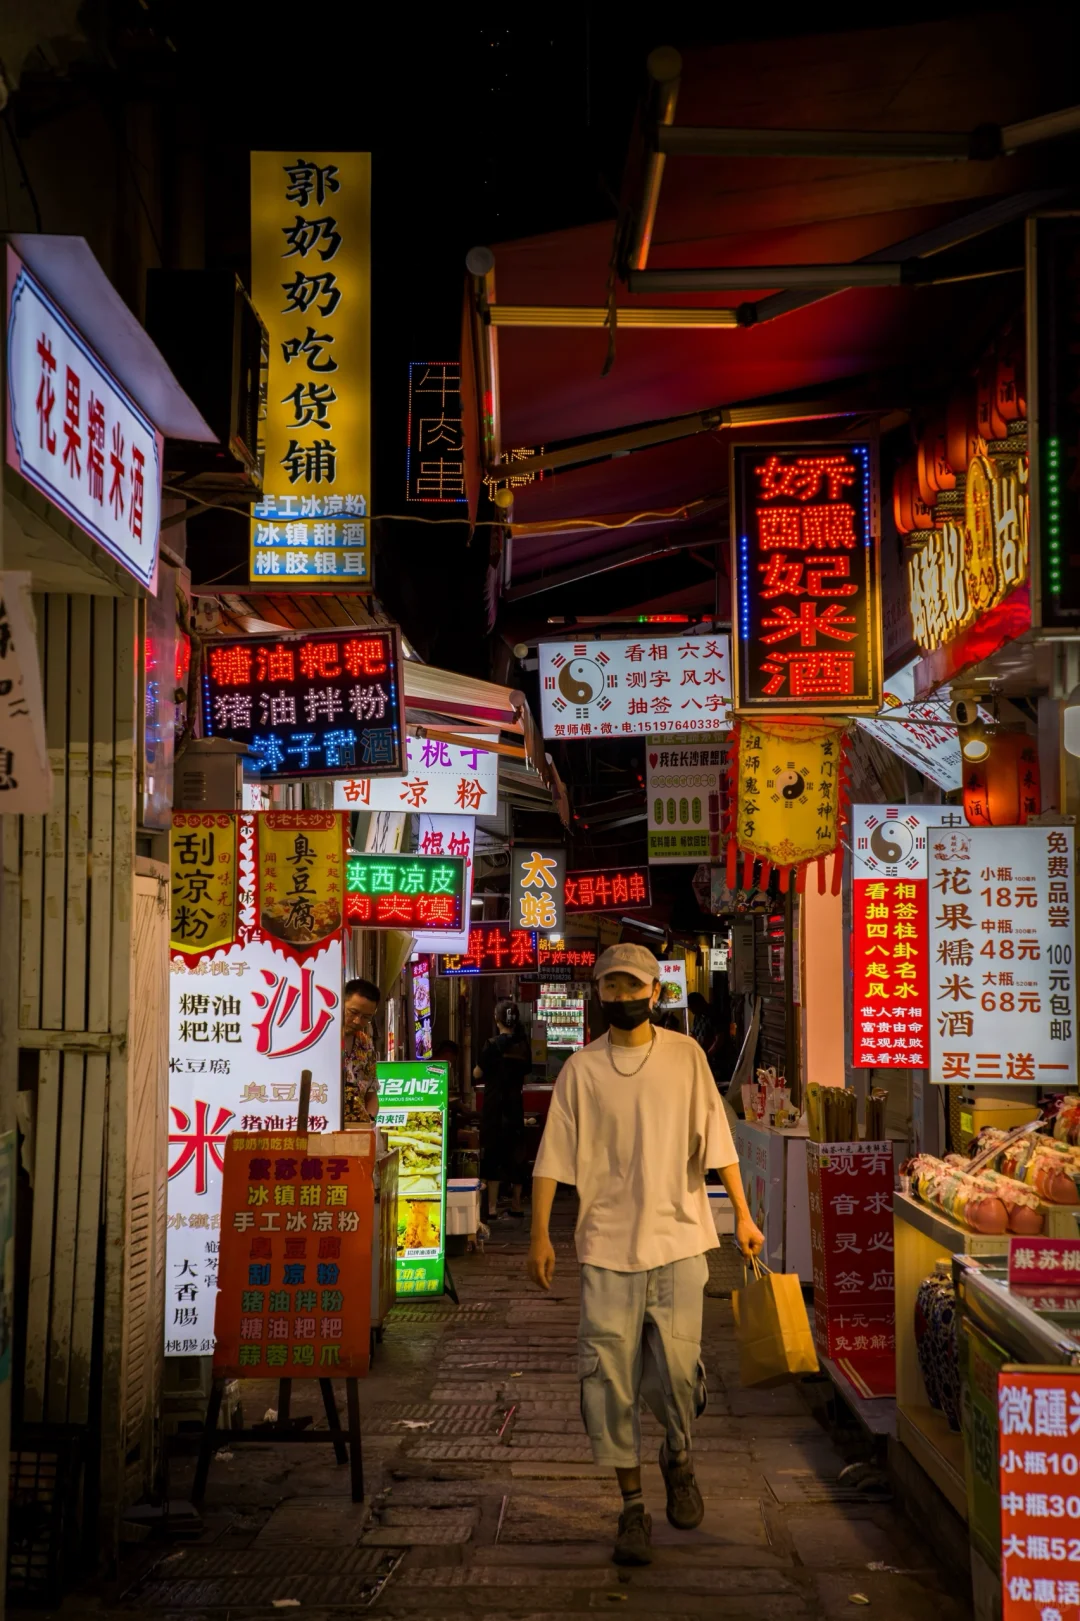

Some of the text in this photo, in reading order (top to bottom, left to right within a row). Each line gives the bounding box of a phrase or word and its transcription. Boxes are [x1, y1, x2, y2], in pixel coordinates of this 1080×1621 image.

[280, 159, 342, 485] 郭奶奶吃货铺
[35, 333, 146, 545] 花果糯米酒
[255, 494, 366, 517] 手工冰凉粉
[256, 522, 366, 546] 冰镇甜酒
[256, 551, 366, 575] 桃胶银耳
[210, 639, 387, 685] 糖油粑粑
[625, 644, 668, 662] 看相
[626, 668, 726, 689] 测字 风水
[214, 684, 388, 729] 猪油拌粉
[627, 694, 726, 715] 抽签 八字
[406, 738, 490, 770] 桃子
[343, 777, 488, 810] 刮凉粉
[743, 735, 763, 838] 祖师鬼谷子
[173, 815, 230, 828] 长沙小吃
[276, 814, 324, 826] 老长沙
[285, 833, 317, 932] 臭豆腐
[980, 867, 1012, 881] 小瓶
[171, 832, 215, 939] 刮凉粉
[520, 852, 557, 928] 太蚝
[864, 882, 917, 899] 看相
[980, 887, 1038, 908] 18元
[865, 903, 918, 919] 抽签
[866, 923, 918, 939] 四柱
[981, 919, 1012, 933] 中瓶
[1047, 831, 1072, 1041] 免费品尝 100元包邮
[864, 942, 918, 959] 八卦
[932, 867, 977, 1038] 花果糯米酒
[980, 939, 1041, 961] 48元
[865, 961, 917, 979] 起名
[982, 971, 1013, 986] 大瓶
[865, 981, 919, 998] 风水
[179, 994, 241, 1017] 糖油
[860, 1006, 922, 1018] 世人有相
[981, 991, 1041, 1013] 68元
[251, 967, 339, 1060] 沙
[178, 1021, 242, 1043] 粑粑
[860, 1022, 923, 1034] 富贵由命
[860, 1038, 923, 1049] 近观成败
[169, 1057, 231, 1075] 米豆腐
[860, 1053, 923, 1065] 远看兴衰
[942, 1052, 1069, 1080] 买三送一
[168, 1100, 236, 1196] 米
[248, 1158, 349, 1180] 紫苏桃子
[247, 1185, 348, 1206] 冰镇甜酒
[233, 1211, 360, 1233] 手工冰凉粉
[250, 1237, 342, 1259] 臭豆腐
[248, 1263, 339, 1285] 刮凉粉
[174, 1259, 198, 1327] 大香腸
[241, 1291, 344, 1313] 猪油拌粉
[240, 1317, 343, 1339] 糖油粑粑
[239, 1344, 341, 1366] 蒜蓉鸡爪
